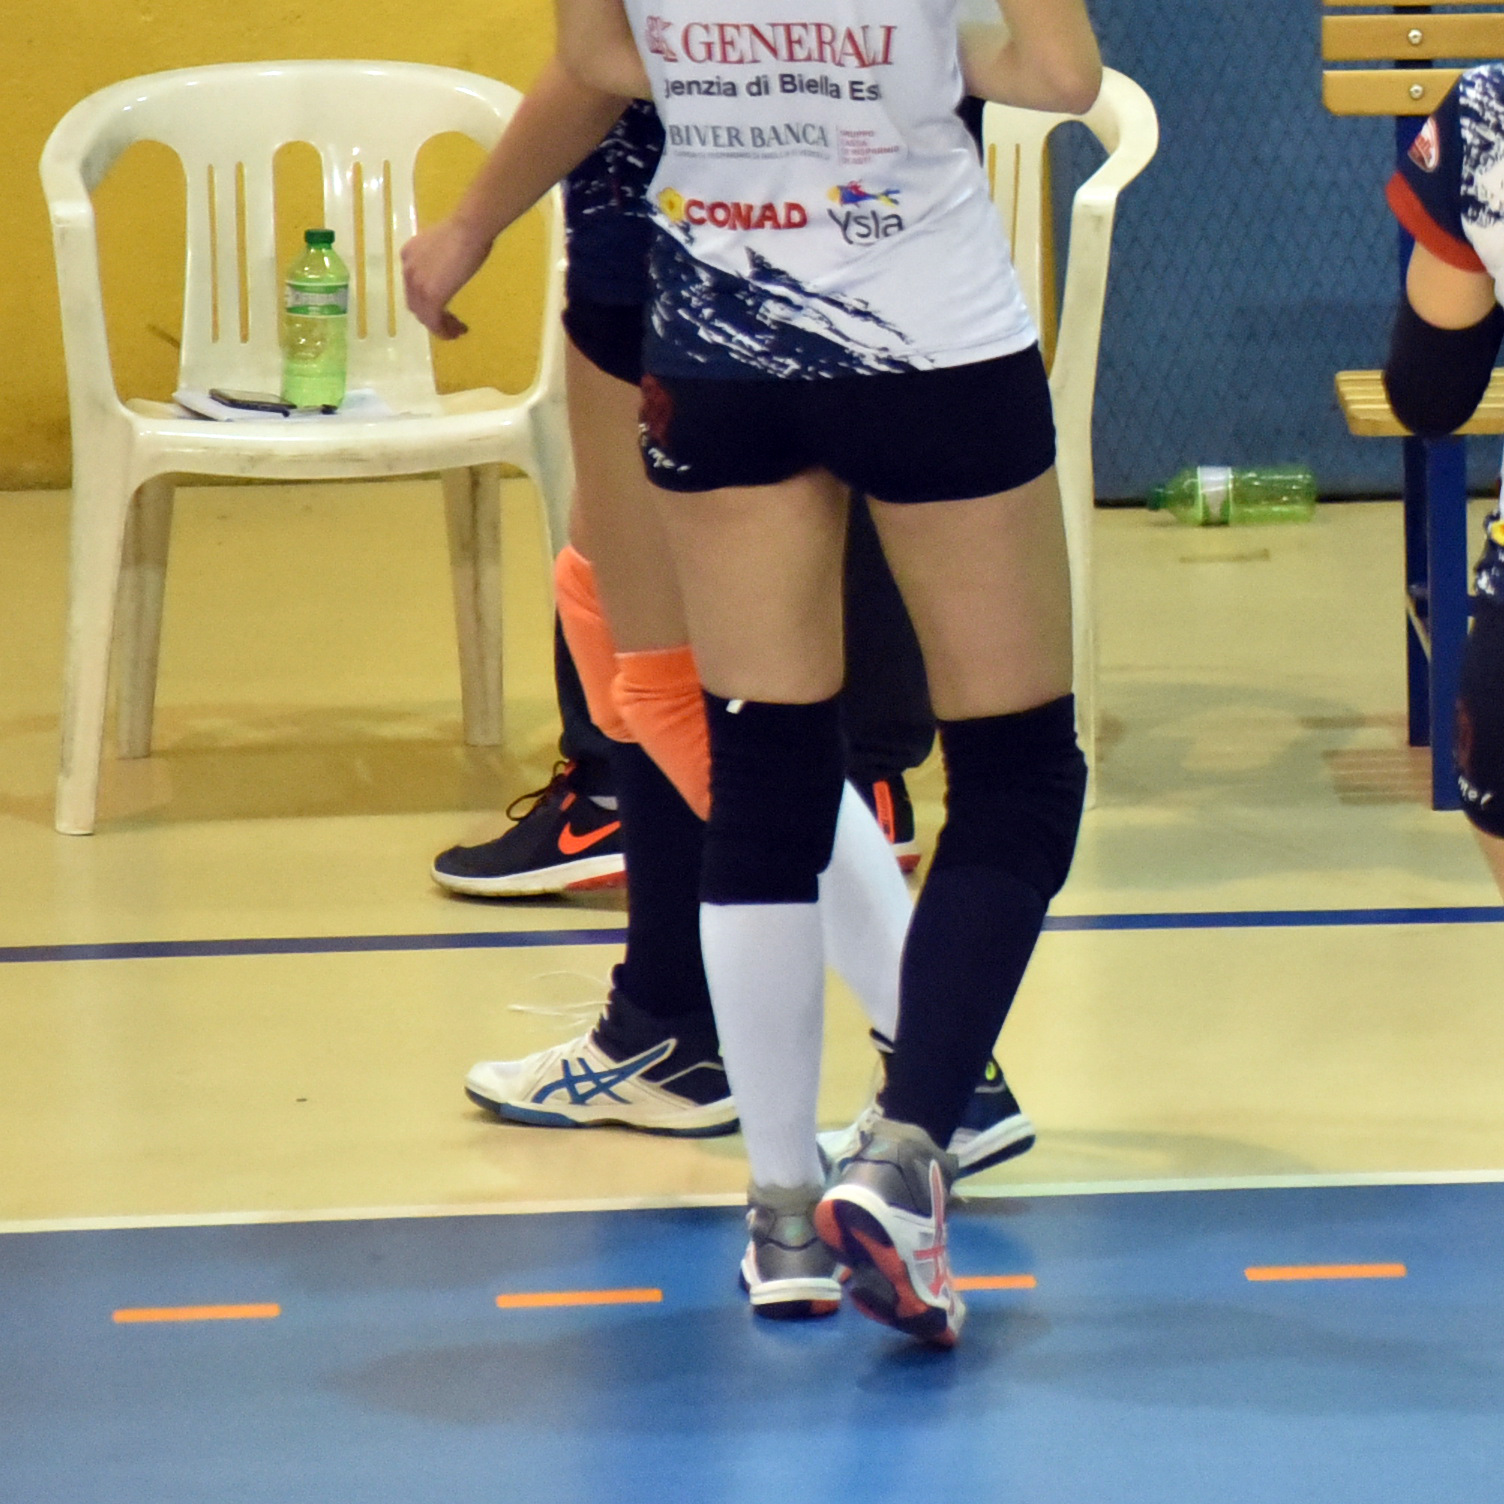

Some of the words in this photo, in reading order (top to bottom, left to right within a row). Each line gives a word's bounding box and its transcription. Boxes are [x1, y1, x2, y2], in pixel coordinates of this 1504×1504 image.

[681, 21, 898, 69] GENERALI
[664, 76, 738, 98] enzia
[745, 74, 770, 96] di
[779, 73, 841, 99] Biella
[848, 80, 880, 101] Es
[669, 123, 745, 148] BIVER
[750, 122, 829, 148] BANCA
[684, 199, 808, 231] CONAD
[827, 208, 904, 245] Ysla
